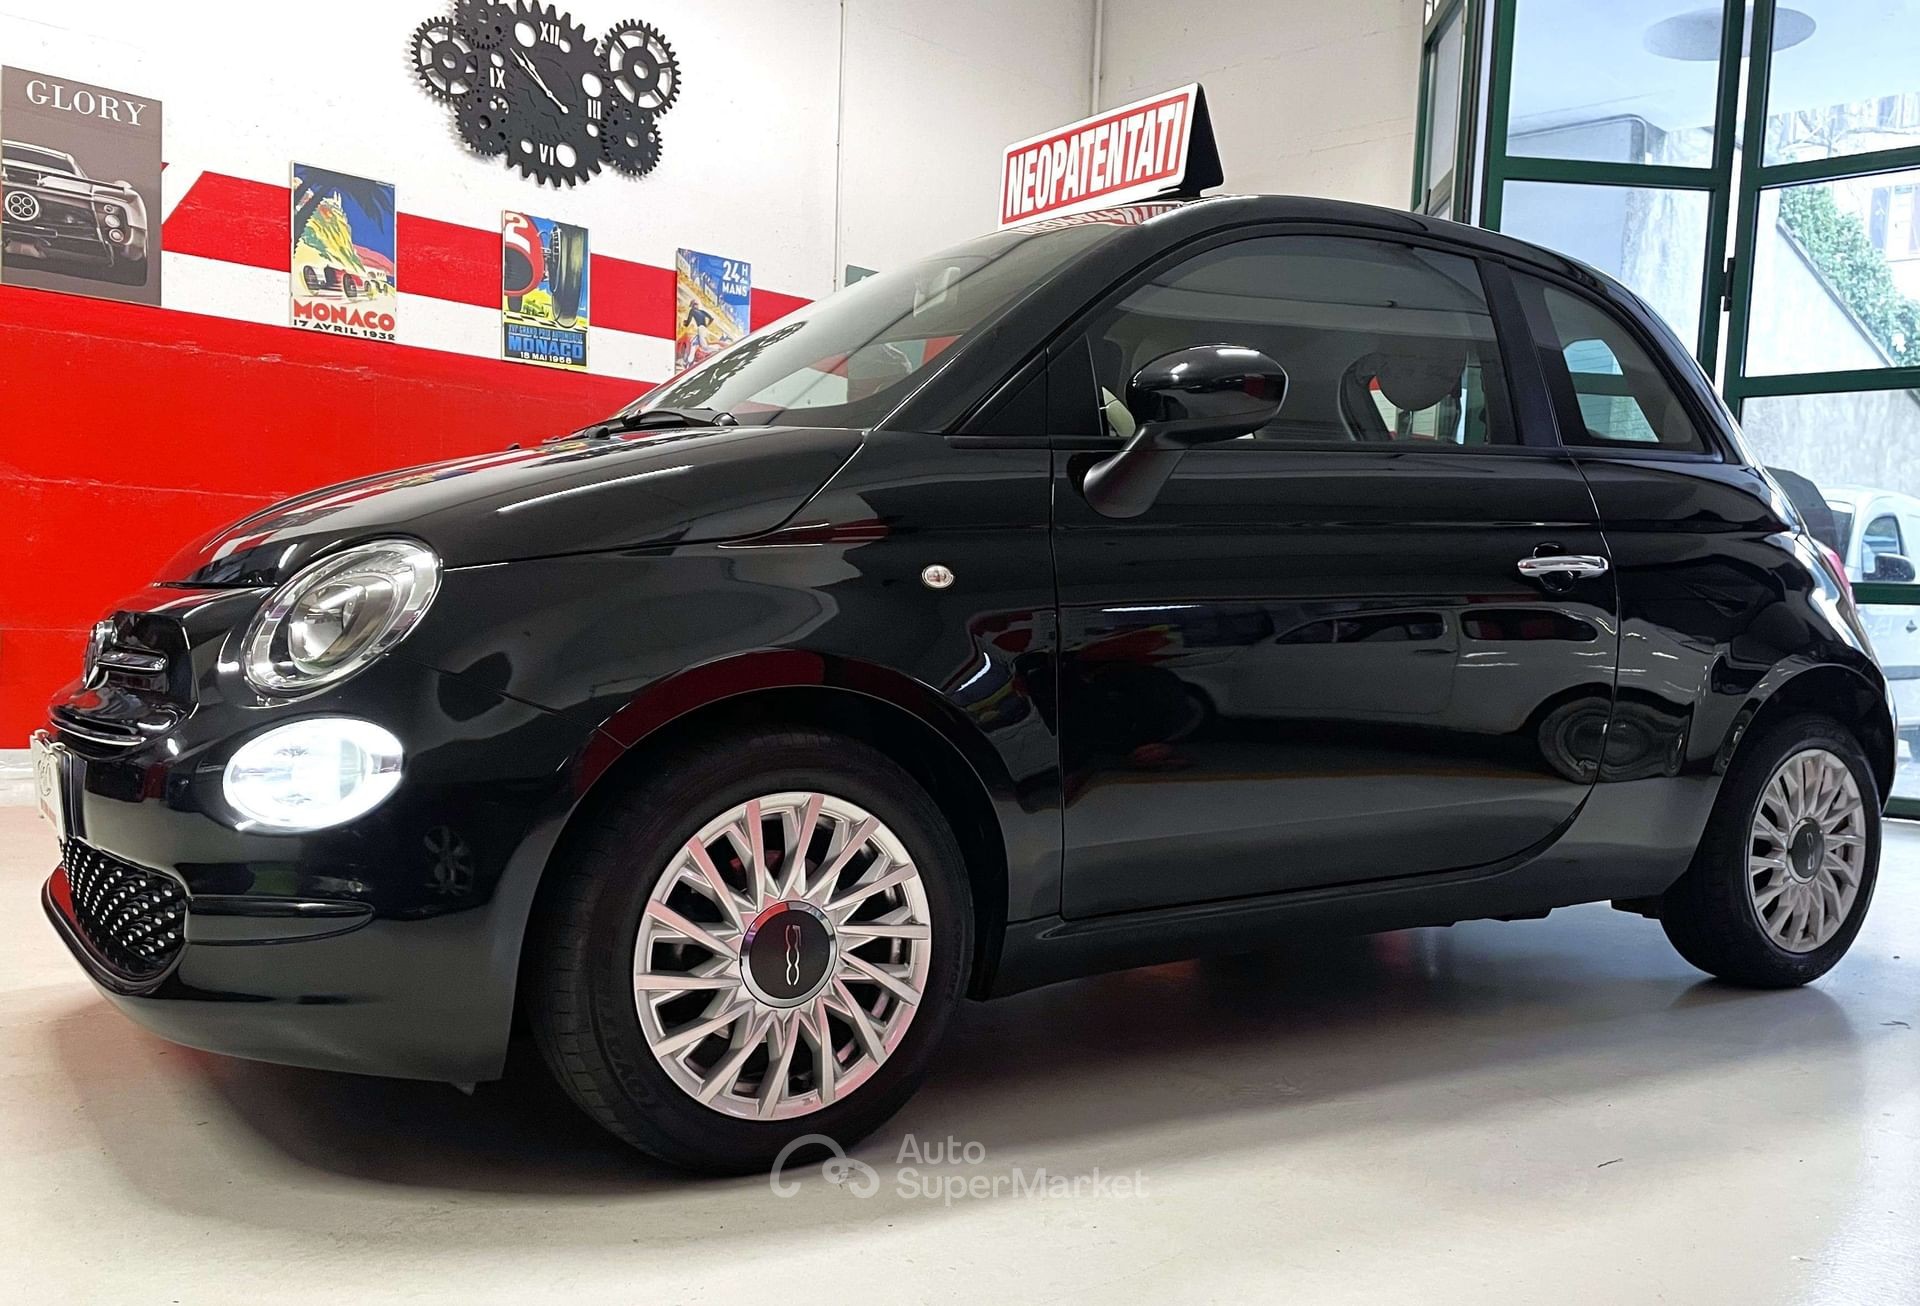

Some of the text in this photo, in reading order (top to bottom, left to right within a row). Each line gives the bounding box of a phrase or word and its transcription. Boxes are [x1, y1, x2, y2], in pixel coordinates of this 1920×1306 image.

[540, 21, 560, 46] XII
[489, 67, 506, 90] IX
[26, 80, 147, 126] GLORY
[588, 98, 601, 120] III
[539, 143, 555, 166] VI
[1006, 101, 1184, 219] NEOPATENTATI
[722, 281, 748, 297] MANS
[293, 299, 396, 332] MONACO
[293, 319, 396, 341] 17 AVRIL 1932
[508, 336, 584, 359] MONACO
[520, 351, 573, 364] 18 MAI 1958
